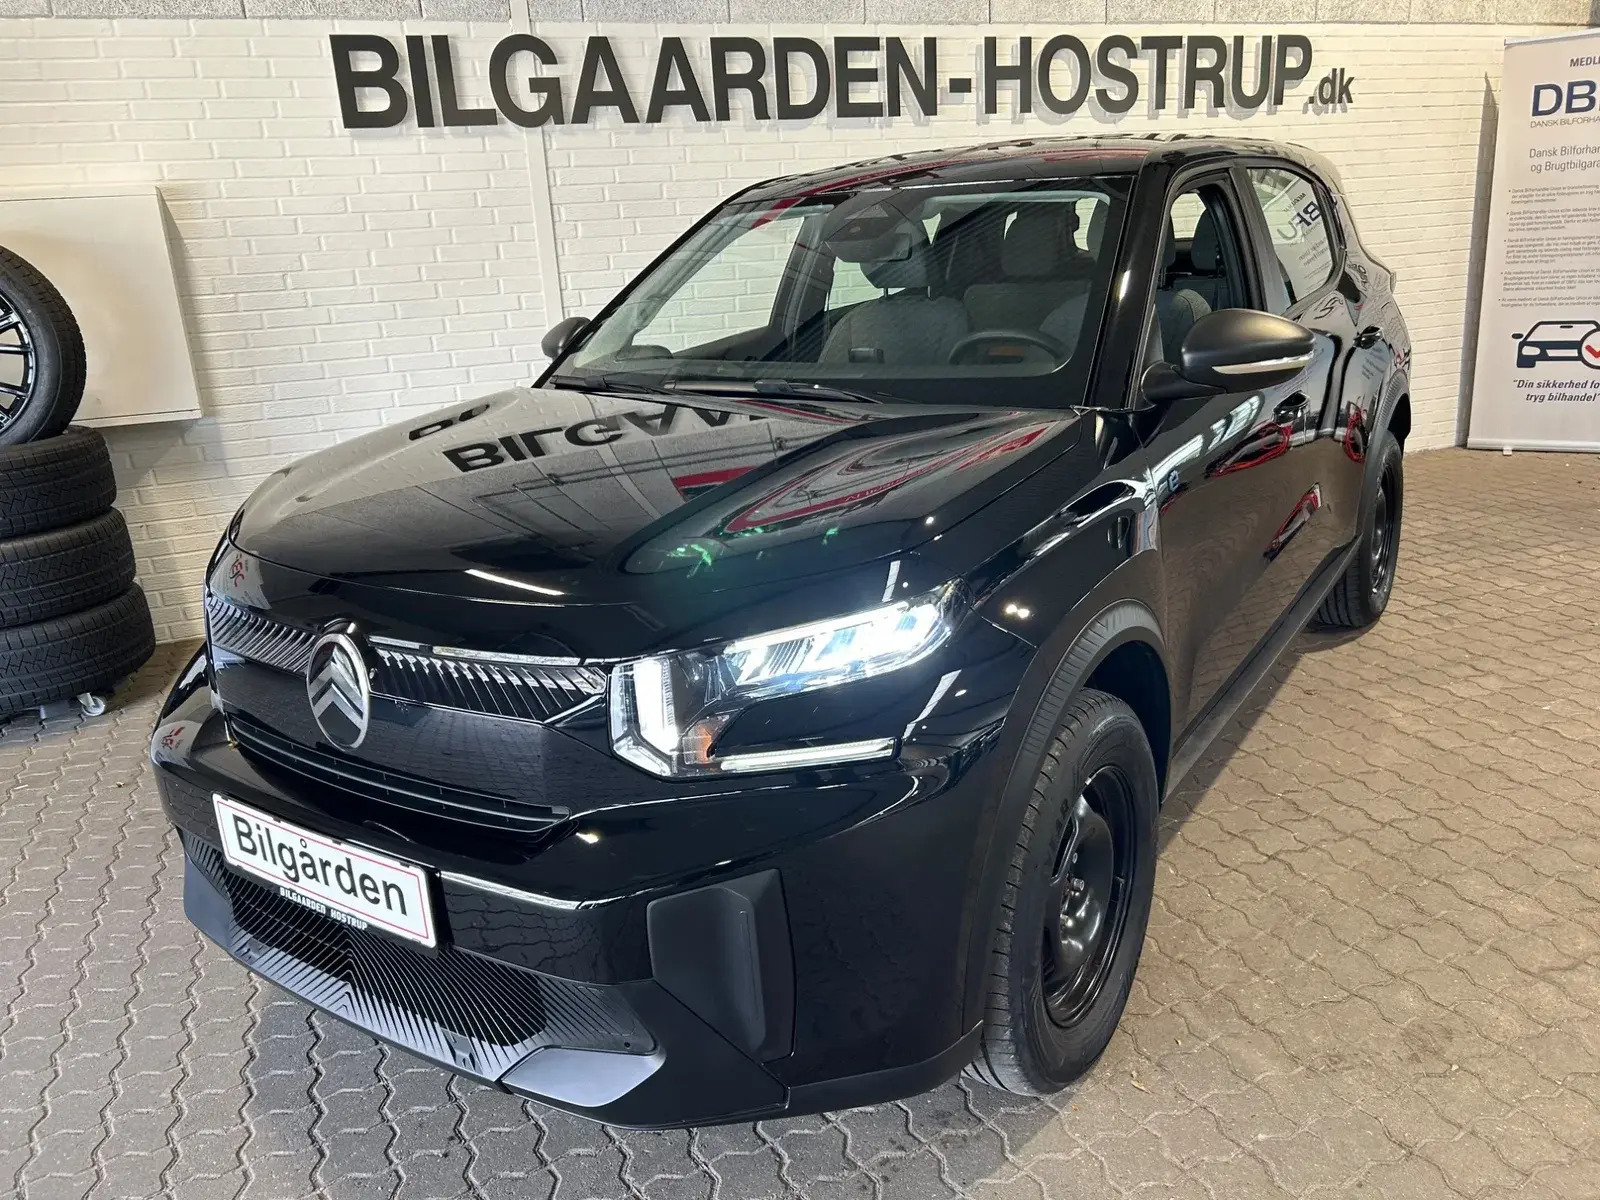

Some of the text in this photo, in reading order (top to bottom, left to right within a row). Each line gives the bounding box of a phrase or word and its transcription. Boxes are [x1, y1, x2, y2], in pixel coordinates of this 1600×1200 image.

[1532, 80, 1600, 117] DB
[1530, 119, 1559, 128] DANSK
[1529, 147, 1558, 158] Dansk
[1530, 164, 1542, 174] og
[1536, 379, 1589, 389] sikkerhed
[1526, 393, 1545, 403] tryg
[232, 813, 408, 917] Bilgården
[280, 886, 368, 931] BILGAARDEN HOSTRUP
